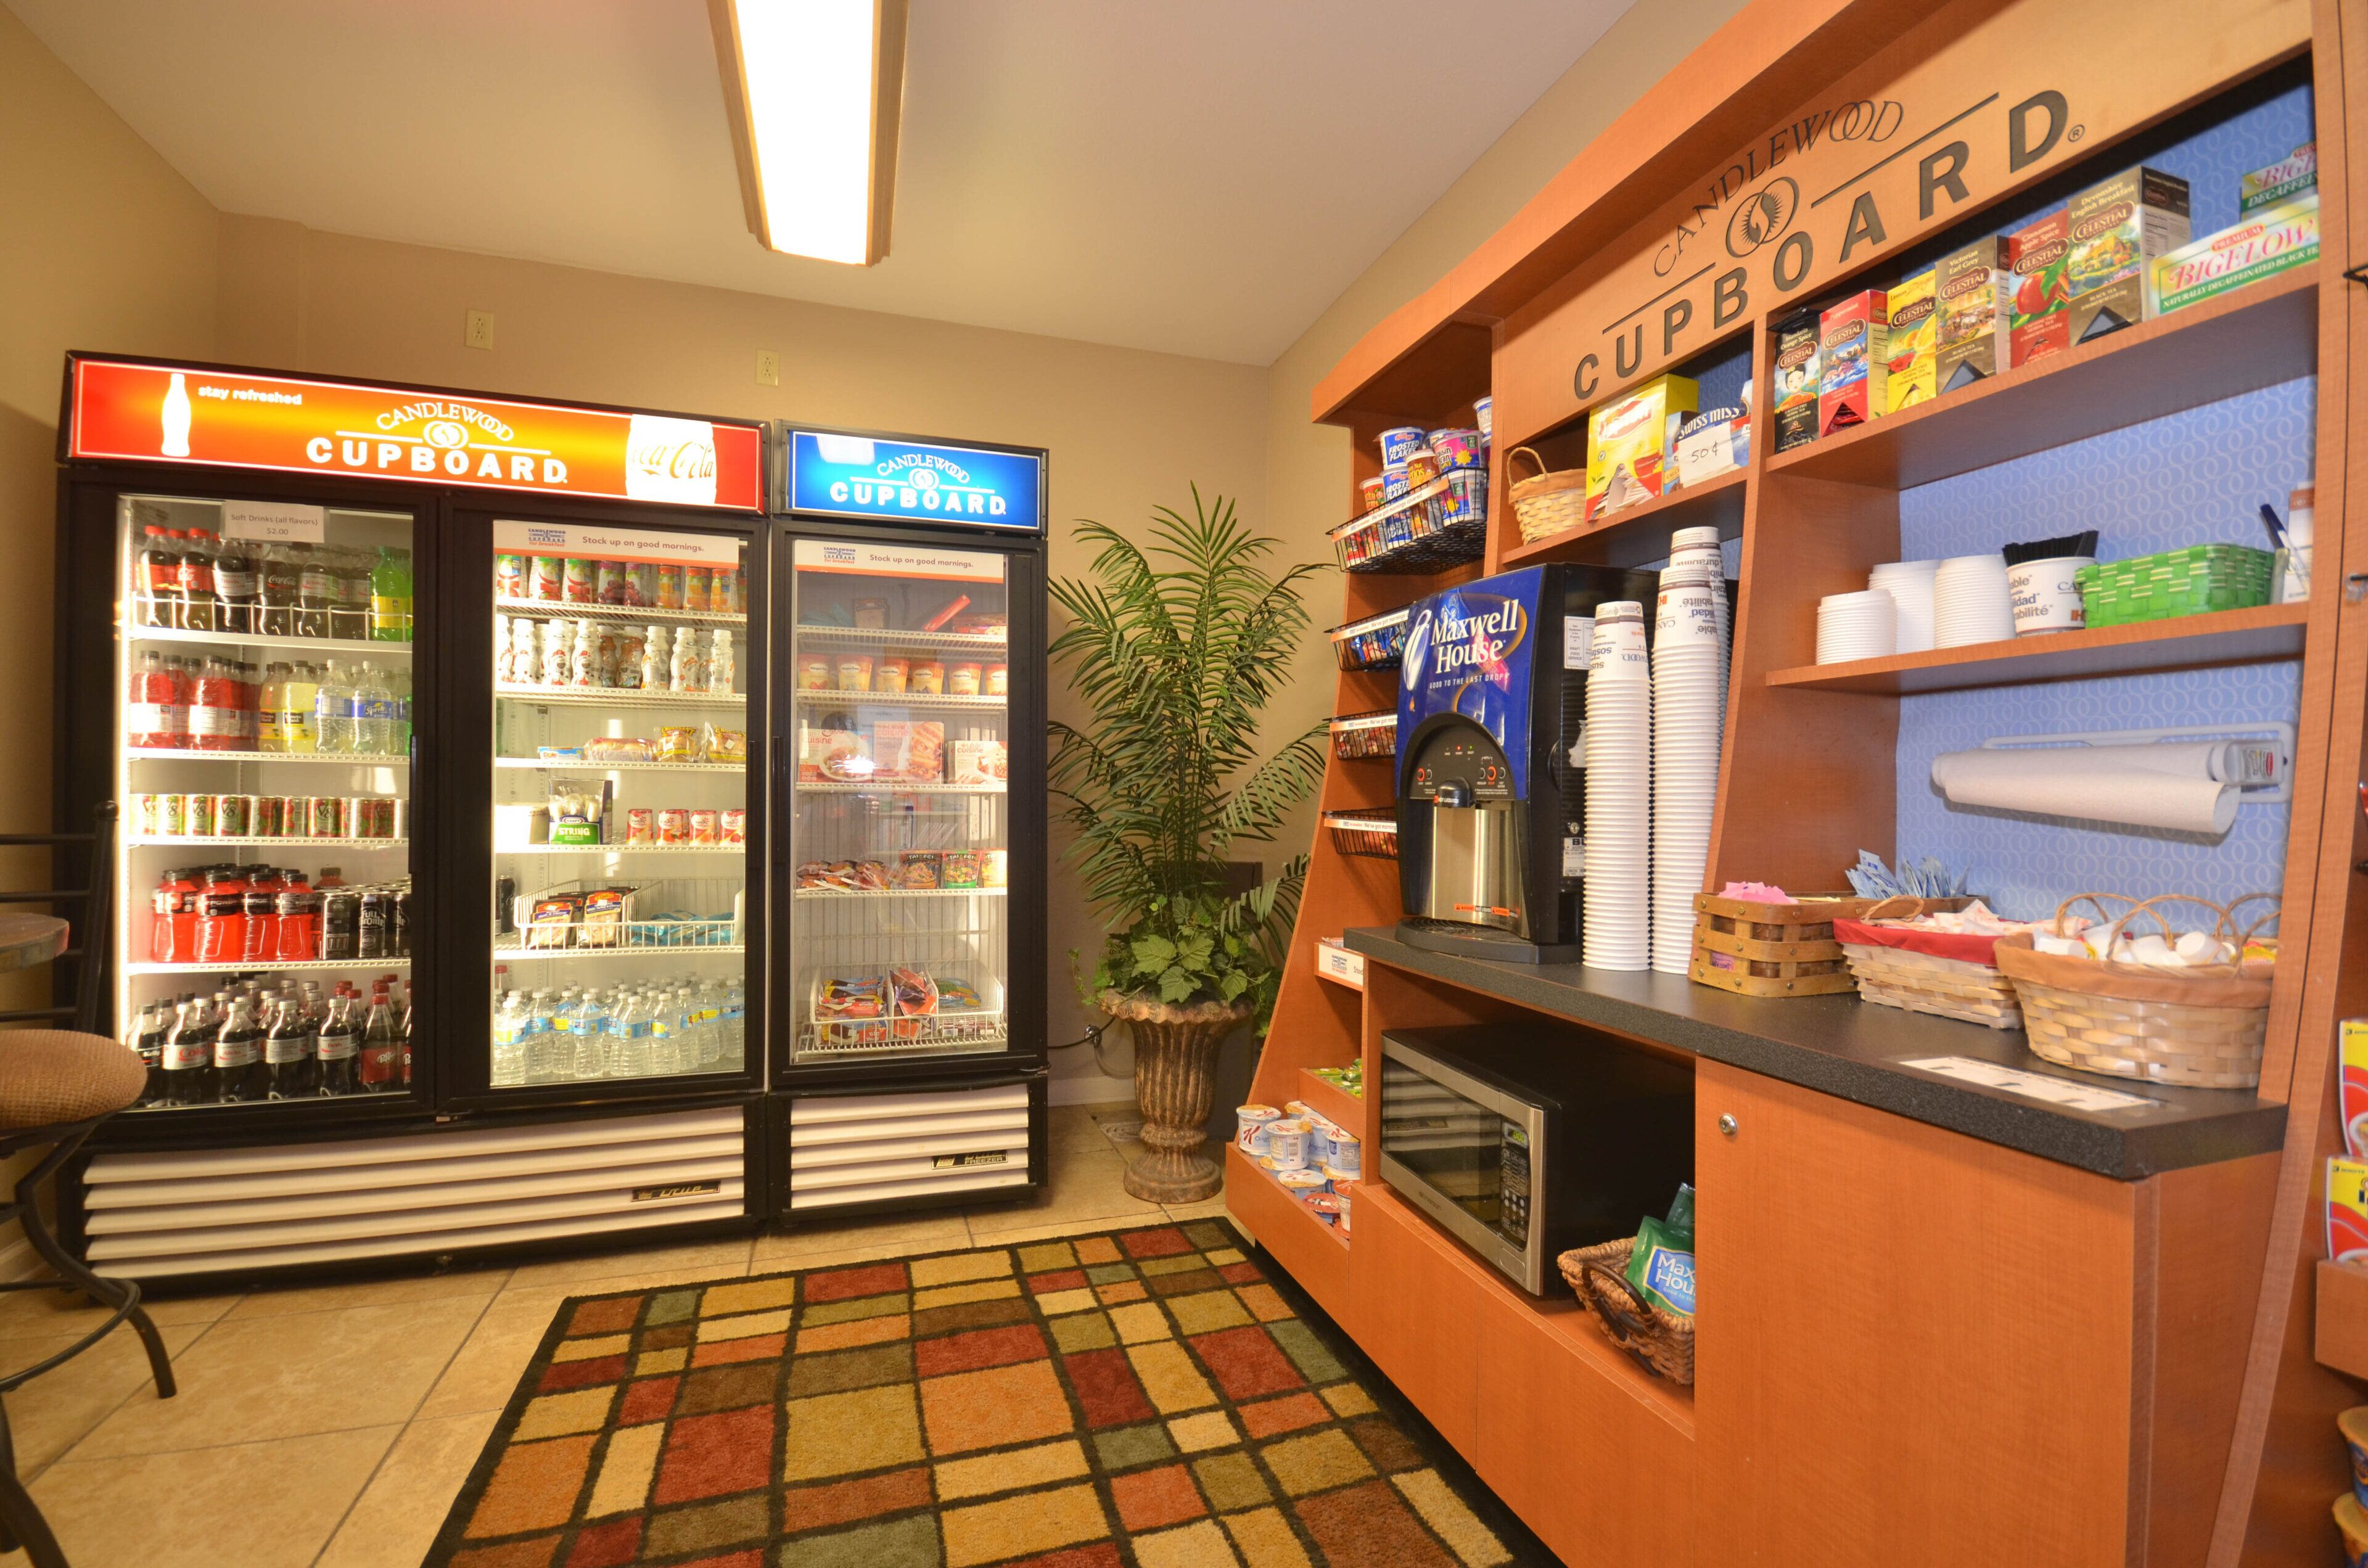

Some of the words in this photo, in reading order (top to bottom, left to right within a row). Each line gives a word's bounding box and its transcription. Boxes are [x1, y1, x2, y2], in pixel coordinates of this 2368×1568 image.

[1653, 100, 1904, 277] CANDLEWOOD
[2081, 182, 2123, 205] Devonshire
[2071, 203, 2097, 218] English
[2099, 185, 2135, 208] Breakfast
[2022, 222, 2057, 242] Cinnamon
[2074, 207, 2128, 239] CELESTIAL
[2020, 236, 2038, 252] Apple
[2039, 228, 2060, 242] Spice
[2213, 225, 2262, 251] PREMIUM
[1949, 250, 1978, 266] Victorian
[2015, 245, 2064, 274] CELESTIAL
[2168, 218, 2315, 292] BIGELOW
[1949, 265, 1962, 275] Earl
[1962, 258, 1980, 271] Grey
[1942, 273, 1986, 298] CELESTIAL
[2163, 284, 2206, 309] NATURALLY
[2207, 259, 2276, 291] DECAFFEINATED
[2276, 249, 2306, 267] BLACK
[1890, 290, 1907, 302] Lemon
[2106, 287, 2117, 295] TEA
[1893, 302, 1935, 326] CELESTIAL
[1780, 339, 1798, 350] Orange
[1798, 332, 1812, 342] Spice
[1825, 324, 1861, 348] CELESTIAL
[1780, 347, 1814, 367] CELESTIAL
[197, 385, 229, 400] stay
[232, 388, 302, 405] refreshed
[376, 402, 514, 442] CANDLEWOOD
[1677, 413, 1708, 440] SWISS
[1710, 407, 1741, 422] MISS
[1388, 439, 1420, 456] FROSTED
[306, 437, 568, 484] CUPBOARD
[876, 453, 970, 484] CANDLEWOOD
[1438, 454, 1452, 464] ran
[829, 481, 1006, 515] CUPBOARD
[231, 512, 247, 523] Soft
[247, 514, 273, 524] Drinks
[275, 514, 287, 527] (all
[288, 515, 319, 527] flavors)
[266, 526, 289, 536] $2.00
[582, 536, 607, 545] Stock
[609, 539, 621, 547] up
[637, 540, 660, 549] good
[662, 542, 704, 553] mornings.
[870, 554, 890, 562] Stock
[916, 557, 935, 566] good
[937, 559, 974, 569] mornings.
[1430, 598, 1519, 646] Maxwell
[1436, 639, 1503, 674] House
[1429, 681, 1442, 689] GOOD
[1466, 675, 1483, 684] LAST
[876, 728, 909, 737] cuisine
[956, 747, 984, 755] cuisine
[194, 803, 207, 818] V8
[222, 803, 237, 818] V8
[317, 805, 334, 819] V8
[558, 827, 590, 836] STRING
[363, 909, 378, 918] FULL
[1243, 1125, 1261, 1145] K
[964, 1157, 1003, 1165] FREEZER
